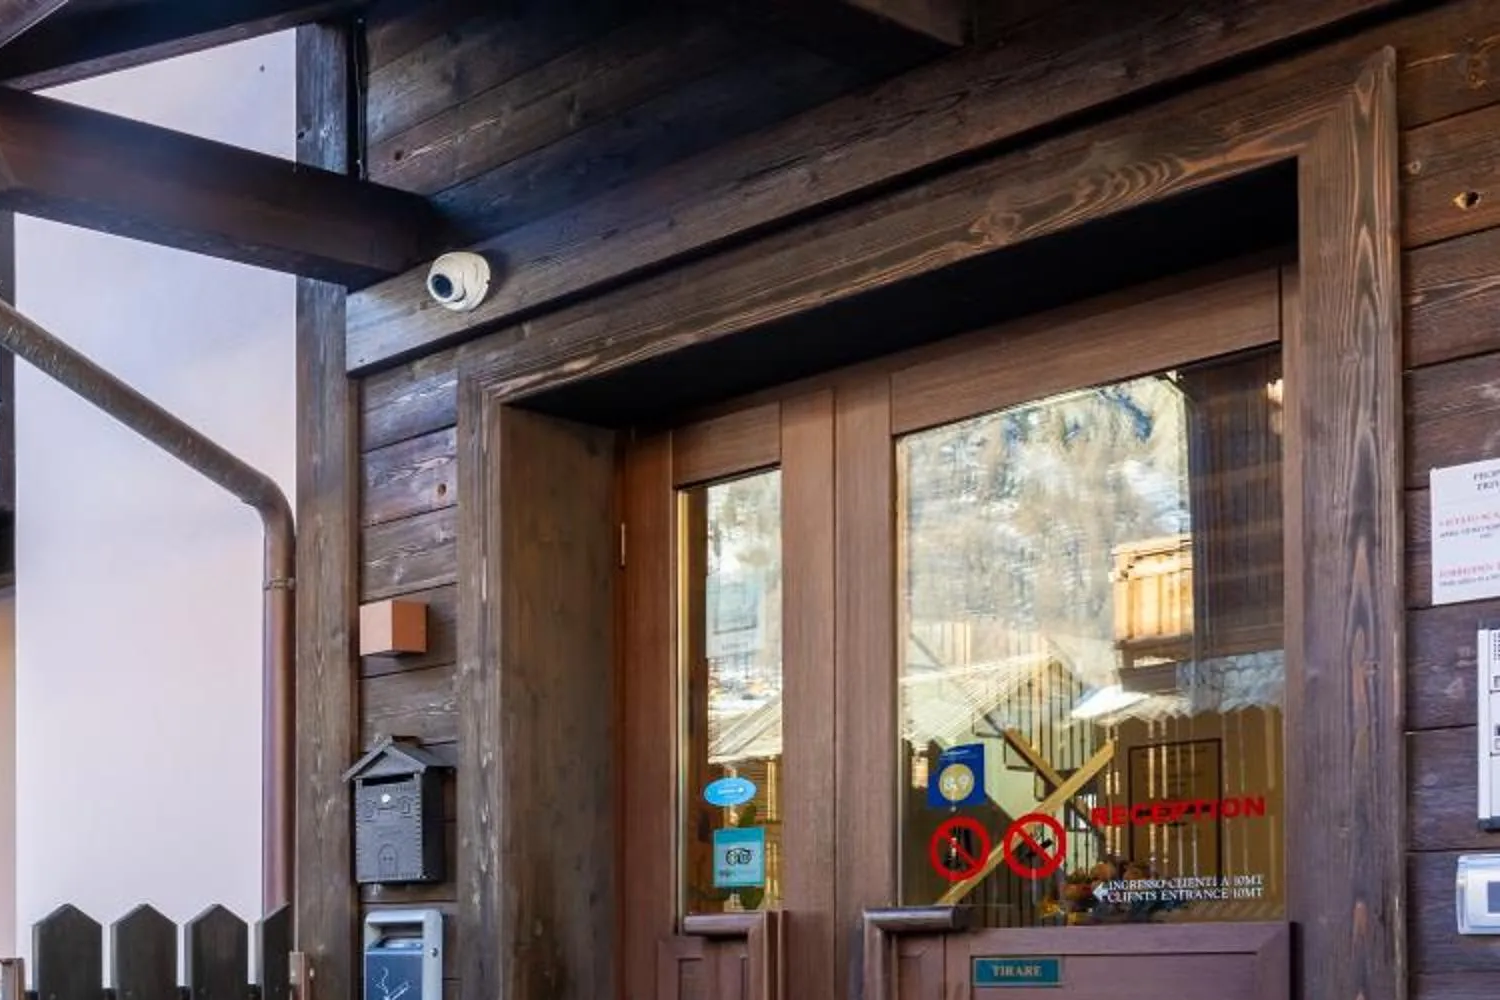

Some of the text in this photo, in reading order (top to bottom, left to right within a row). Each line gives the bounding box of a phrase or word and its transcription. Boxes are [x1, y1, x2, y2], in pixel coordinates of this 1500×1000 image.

[1091, 796, 1266, 828] RECEPTION
[1107, 890, 1157, 903] CLIENTS
[1161, 888, 1229, 901] ENTRANCE
[992, 965, 1043, 977] TIRARE
